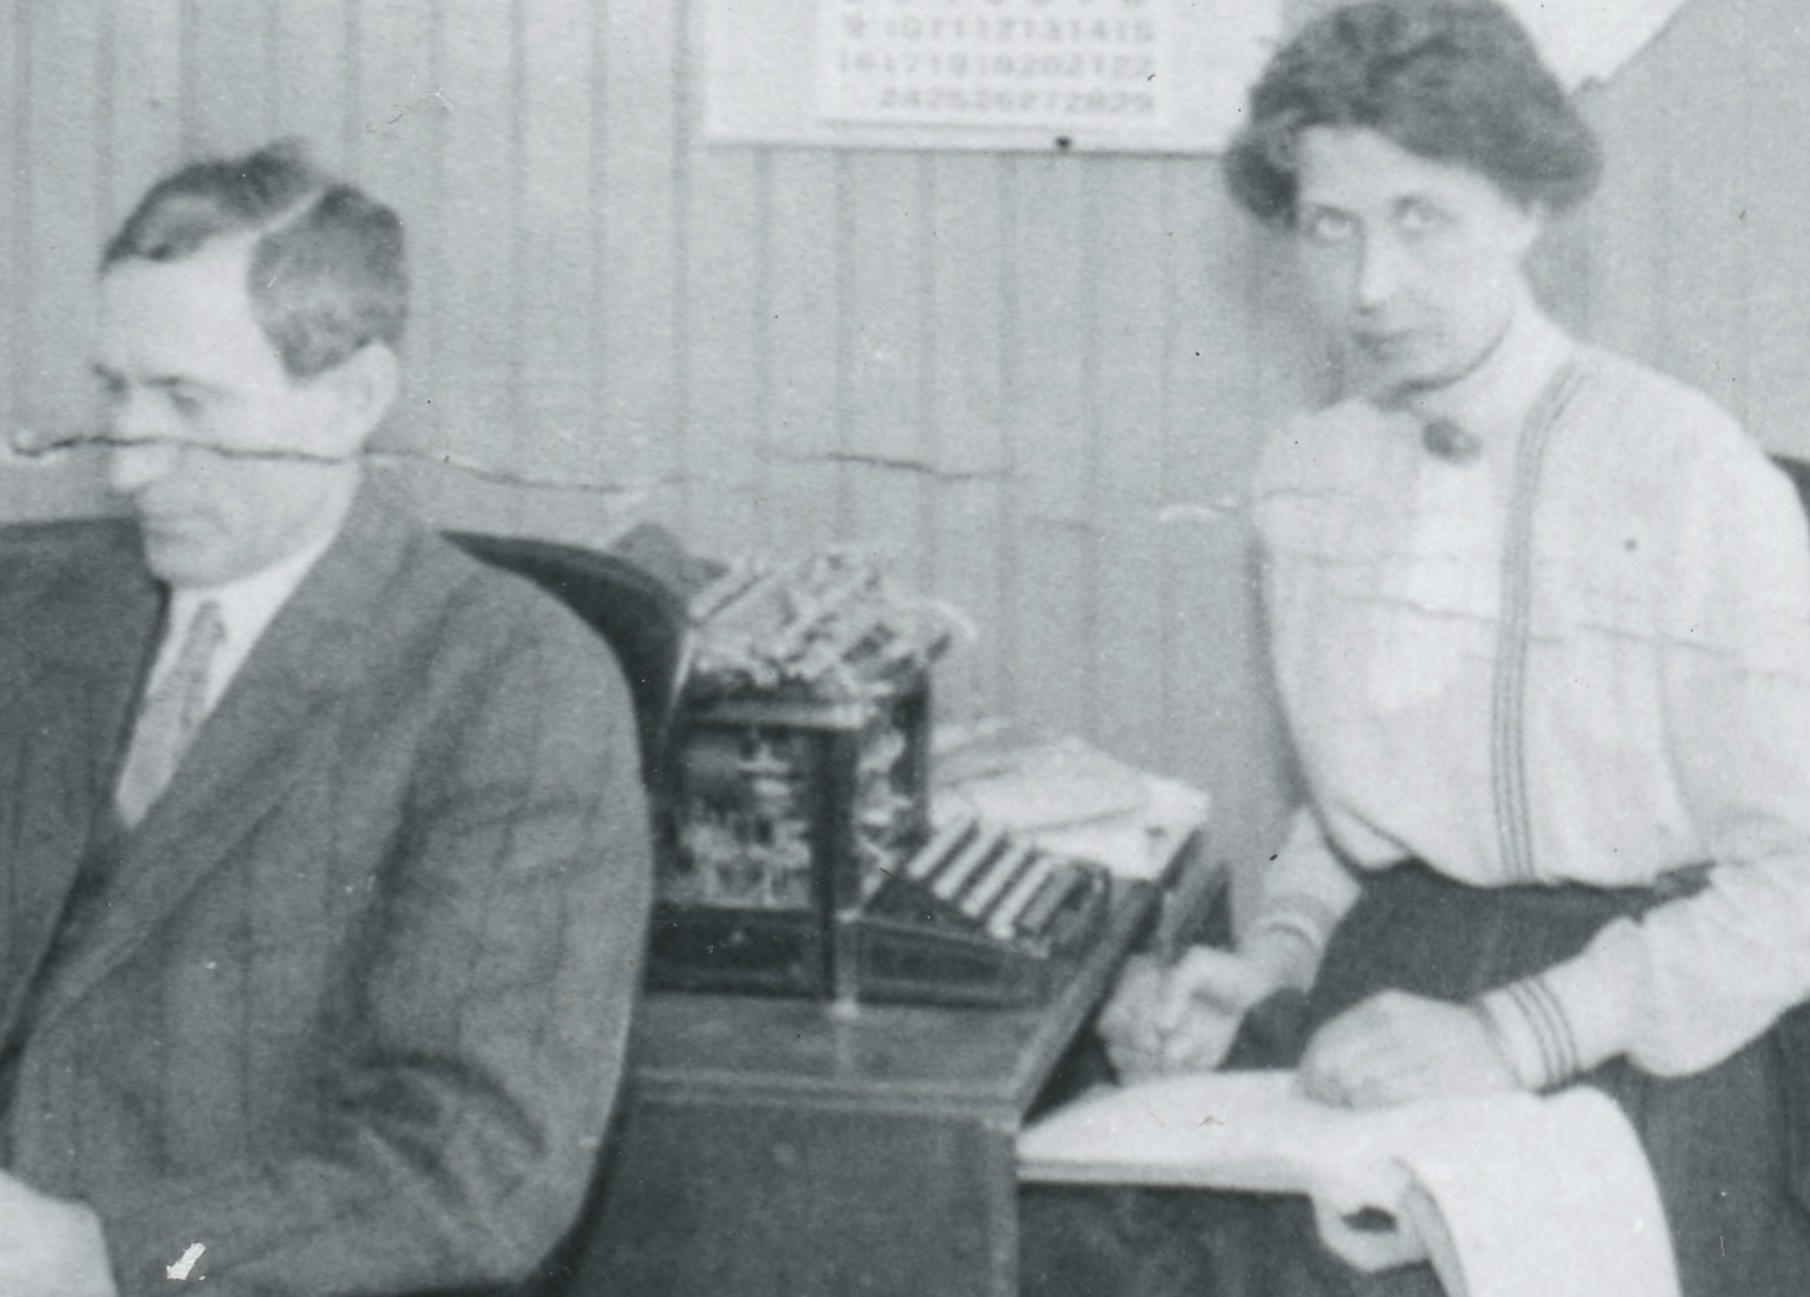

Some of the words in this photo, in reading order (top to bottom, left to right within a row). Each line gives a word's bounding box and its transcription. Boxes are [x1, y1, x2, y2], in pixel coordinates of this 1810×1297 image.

[886, 15, 923, 43] 10
[930, 15, 966, 42] 11
[976, 15, 1017, 43] 12
[1023, 16, 1064, 44] 13
[1070, 16, 1109, 44] 14
